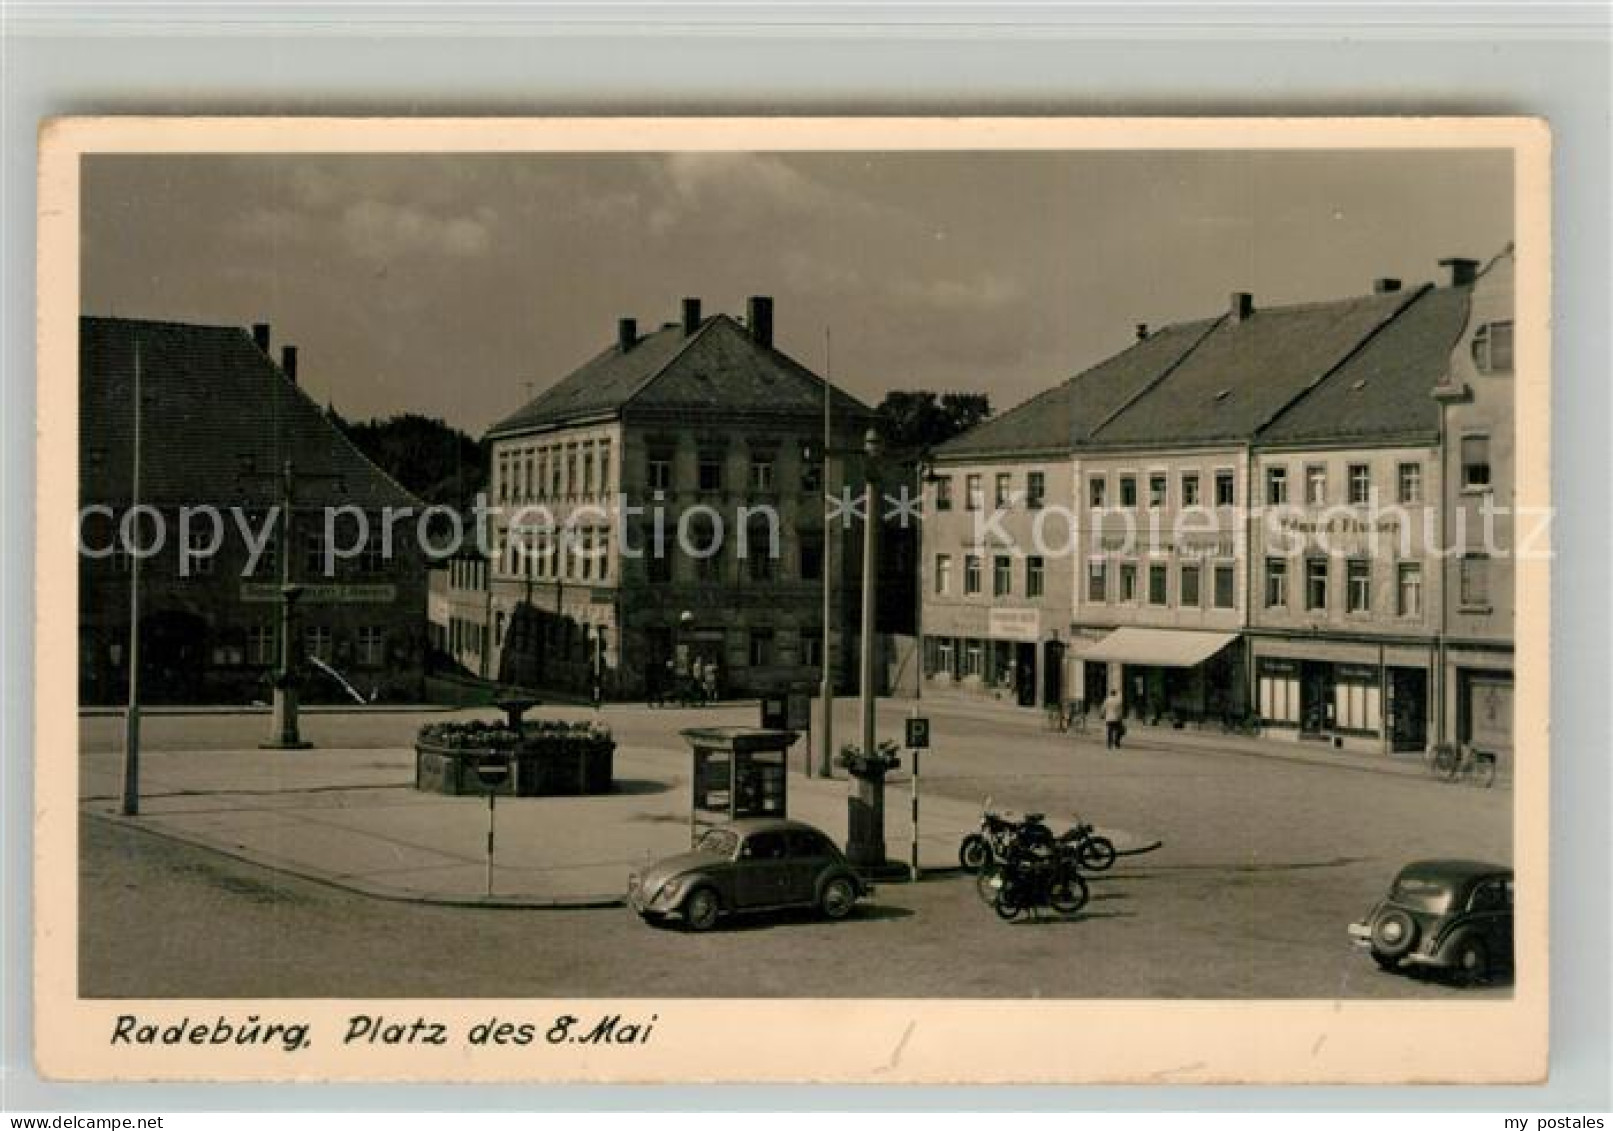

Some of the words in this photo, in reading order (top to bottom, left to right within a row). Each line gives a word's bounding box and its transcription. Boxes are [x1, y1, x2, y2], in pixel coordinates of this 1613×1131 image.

[911, 720, 925, 744] P
[343, 1014, 448, 1045] Platz
[468, 1016, 536, 1045] des
